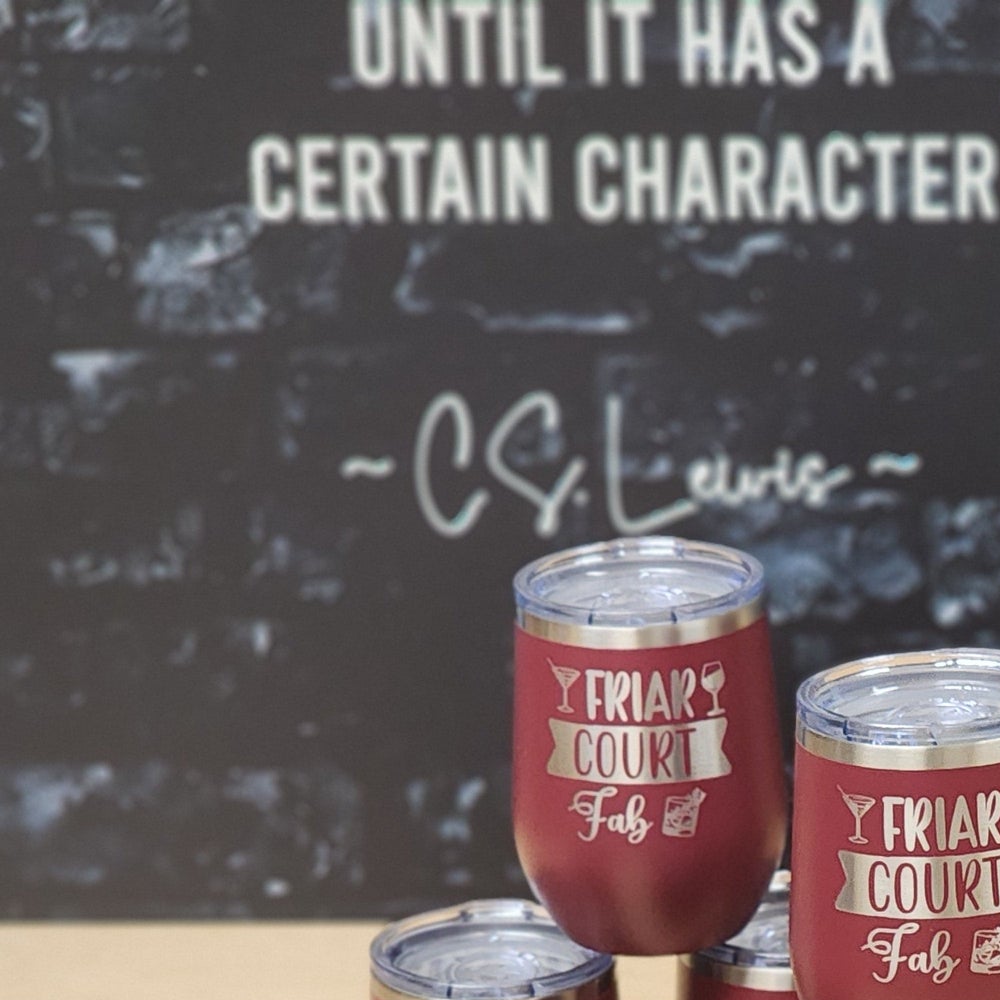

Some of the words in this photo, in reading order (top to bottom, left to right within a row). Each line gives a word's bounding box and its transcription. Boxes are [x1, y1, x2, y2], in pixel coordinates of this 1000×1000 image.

[349, 0, 566, 88] UNTIL
[587, 0, 654, 88] IT
[678, 0, 824, 89] HAS
[844, 0, 894, 88] A
[249, 133, 550, 224] CERTAIN
[575, 132, 1000, 224] CHARACTER
[585, 667, 696, 722] FRIAR
[574, 728, 697, 779] COURT
[568, 786, 653, 844] Fab
[860, 922, 961, 984] Fab
